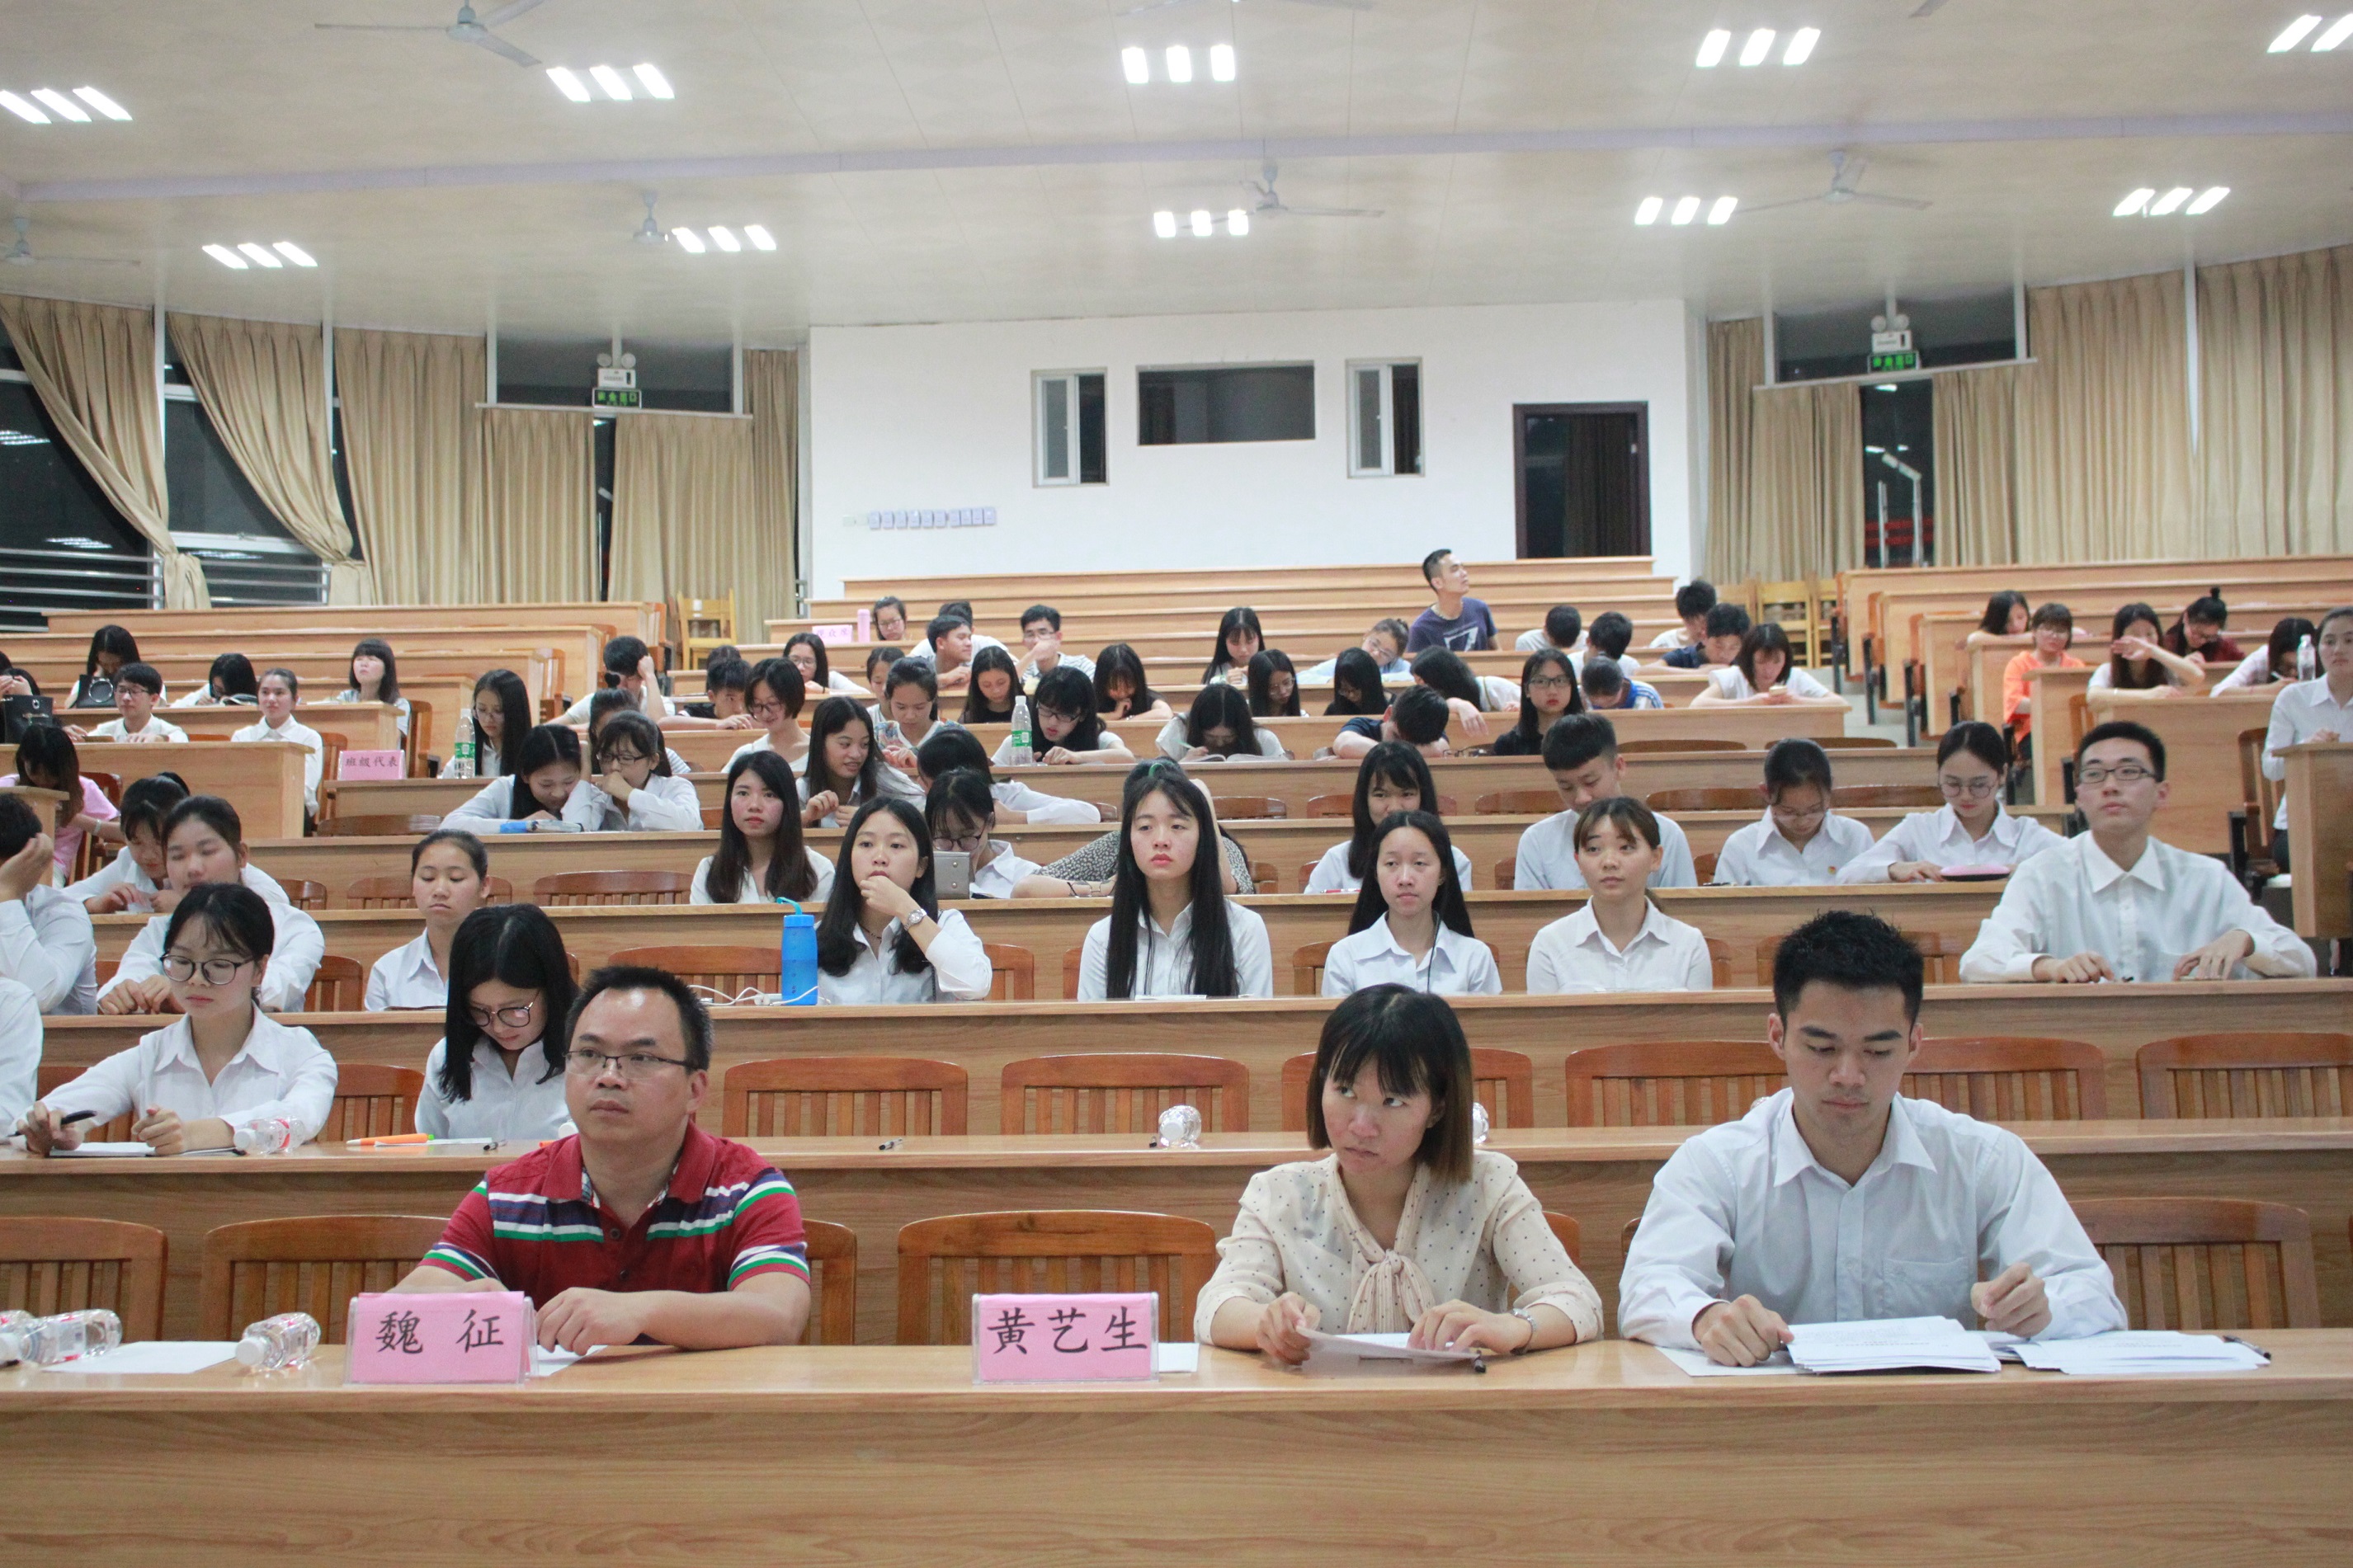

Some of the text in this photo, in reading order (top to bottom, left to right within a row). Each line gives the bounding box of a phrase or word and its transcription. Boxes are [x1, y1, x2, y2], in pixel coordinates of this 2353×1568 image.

[345, 756, 398, 768] 班级代表
[375, 1308, 504, 1354] 魏征
[987, 1306, 1148, 1355] 黄艺生
